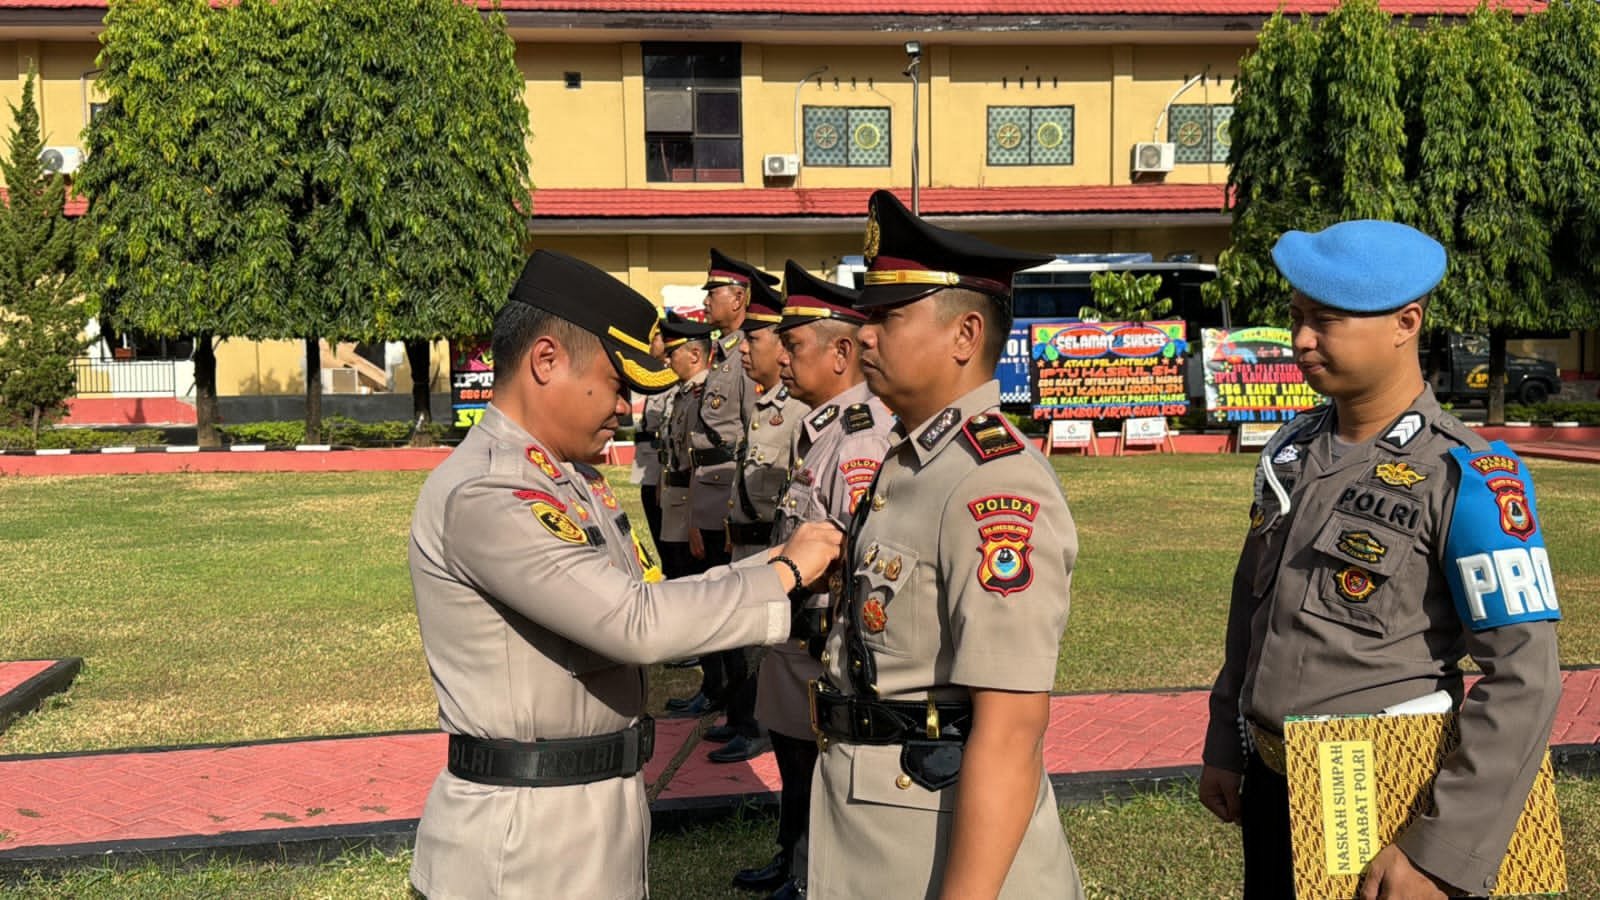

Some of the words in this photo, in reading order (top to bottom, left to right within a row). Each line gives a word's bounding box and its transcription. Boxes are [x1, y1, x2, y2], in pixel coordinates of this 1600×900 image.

[1007, 339, 1029, 356] OL
[1056, 334, 1115, 350] SELAMAT
[1123, 333, 1166, 347] SUKSES
[1064, 359, 1092, 368] ATAS
[454, 372, 494, 387] IPT
[1040, 368, 1079, 379] IPTU
[481, 389, 494, 400] KA
[1040, 387, 1074, 397] IPTU
[1281, 383, 1318, 395] LANTA
[1226, 395, 1271, 407] POLRES
[1275, 395, 1313, 407] MAROS
[843, 459, 877, 470] POLDA
[975, 497, 1033, 515] POLDA
[1339, 487, 1419, 529] POLRI
[449, 741, 494, 776] OLRI
[1330, 744, 1347, 805] SUMPAH
[1352, 749, 1367, 791] POLRI
[1355, 795, 1370, 865] PEJABAT
[1335, 809, 1351, 871] NASKAH
